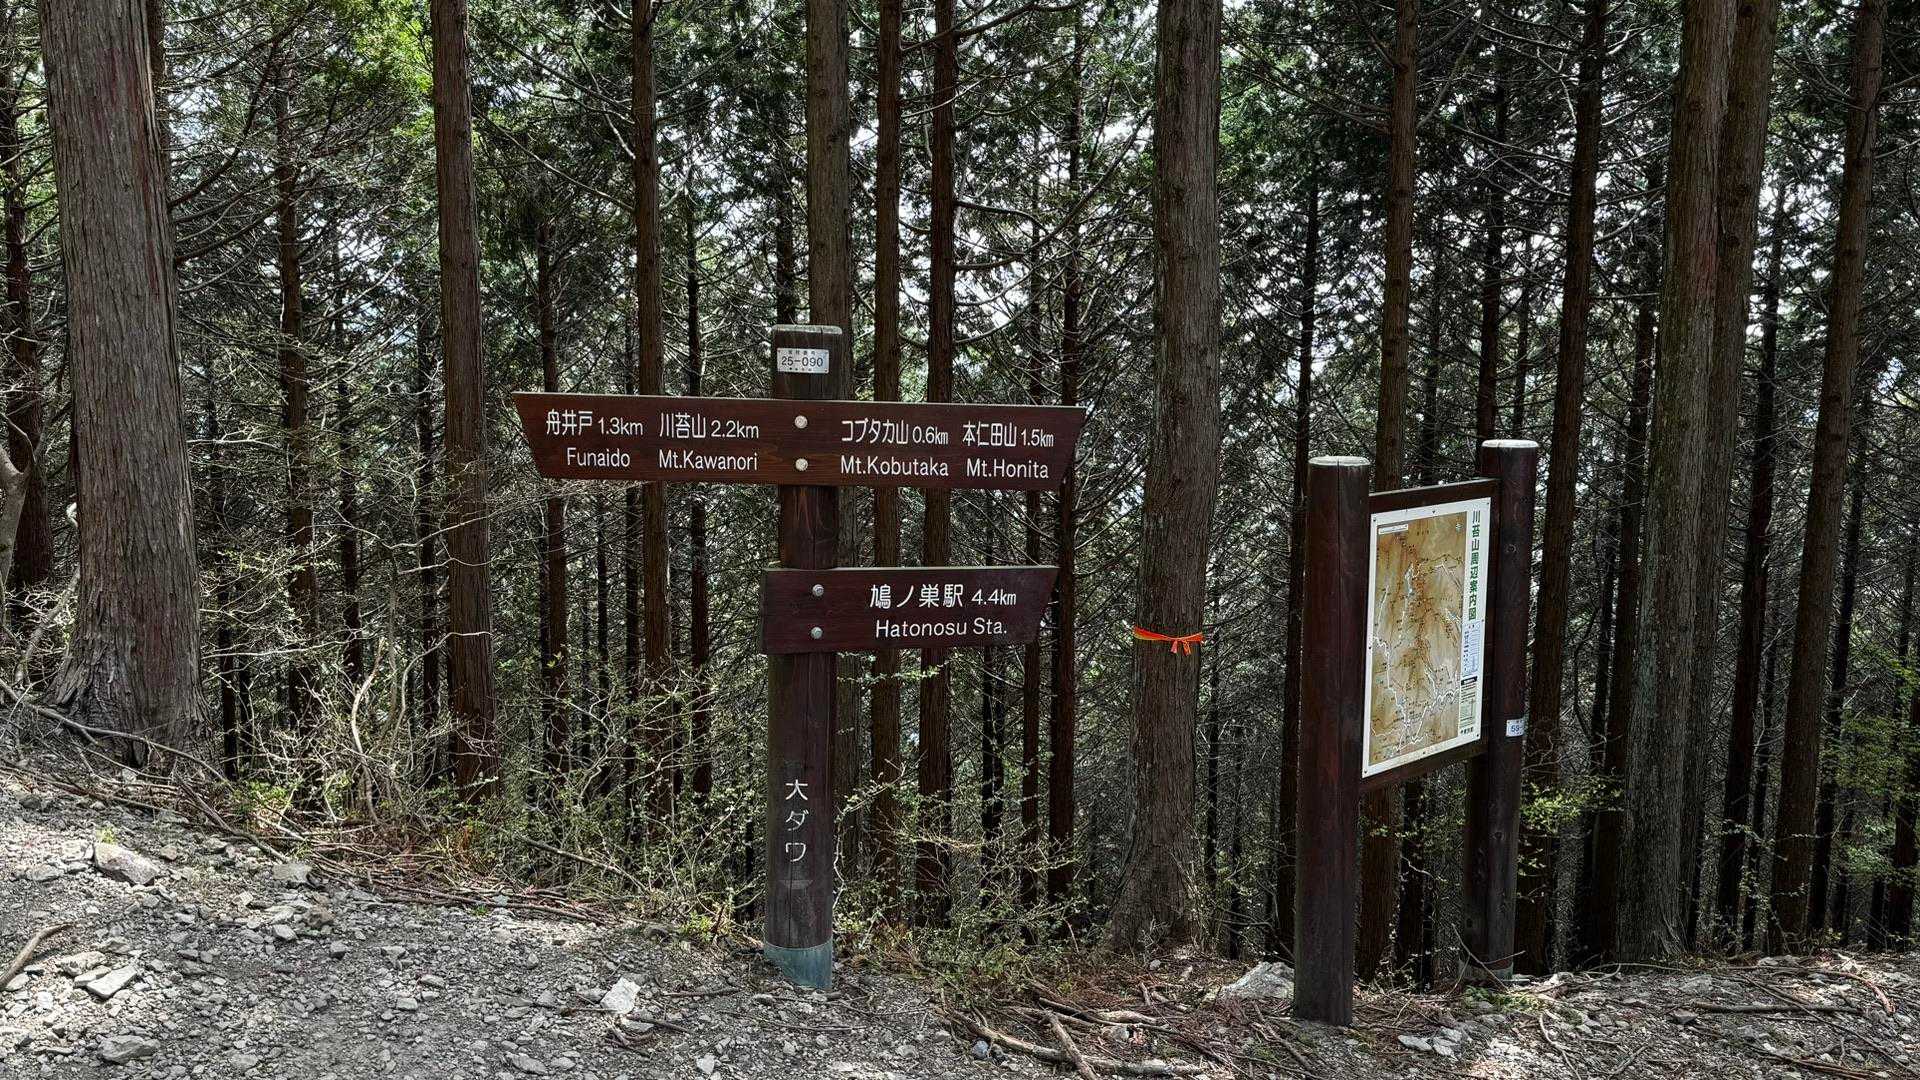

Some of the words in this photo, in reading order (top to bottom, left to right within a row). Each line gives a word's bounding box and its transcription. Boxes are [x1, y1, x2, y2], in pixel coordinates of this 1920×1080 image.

[781, 356, 824, 367] 25-090
[546, 408, 593, 436] 舟井戸
[598, 417, 644, 436] 1.3km
[659, 412, 707, 439] 川苔山
[711, 420, 760, 439] 2.2km
[912, 426, 949, 446] 0.6km
[962, 420, 1017, 447] 本仁田山
[1021, 429, 1055, 447] 1.5km
[566, 447, 631, 468] Funaido
[659, 450, 759, 471] Mt.Kawanori
[841, 455, 949, 477] Mt.Kobutaka
[966, 457, 1049, 479] Mt.Honita
[869, 583, 964, 609] 鳩ノ巣駅
[971, 588, 1017, 606] 4.4km
[875, 619, 968, 638] Hatonosu
[972, 617, 1008, 635] Sta.
[785, 779, 810, 863] 大ダワ
